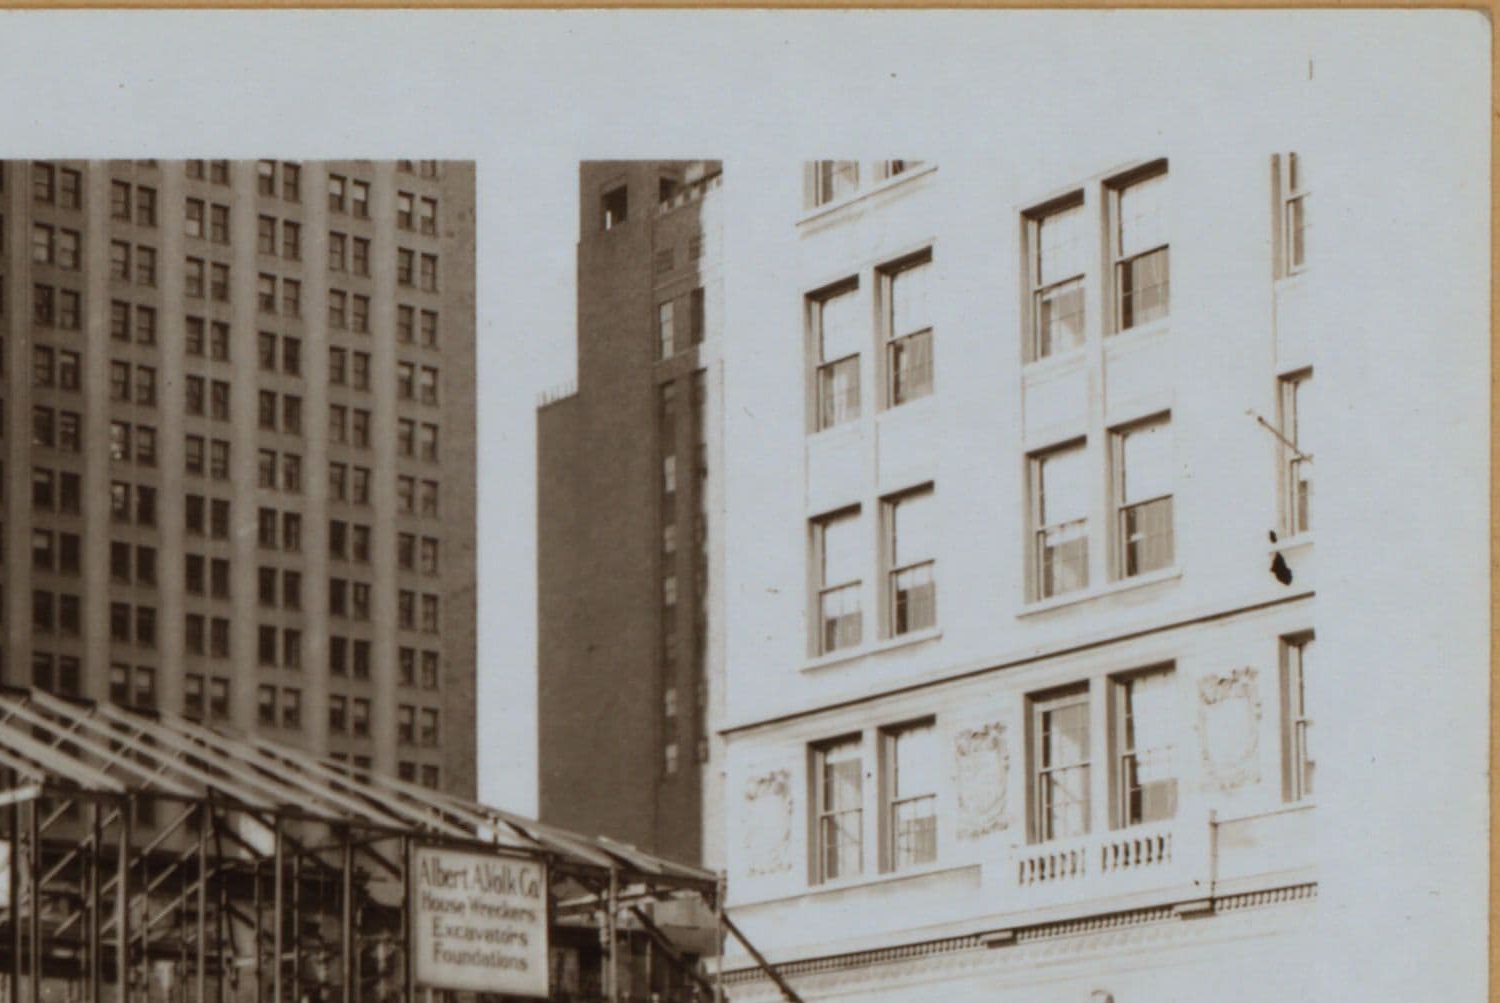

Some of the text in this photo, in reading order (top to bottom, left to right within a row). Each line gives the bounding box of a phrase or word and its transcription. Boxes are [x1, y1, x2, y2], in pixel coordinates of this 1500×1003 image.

[420, 856, 468, 889] Albert
[420, 890, 537, 924] House Wreckers
[432, 915, 528, 947] Excavators
[433, 941, 529, 972] Foundations
